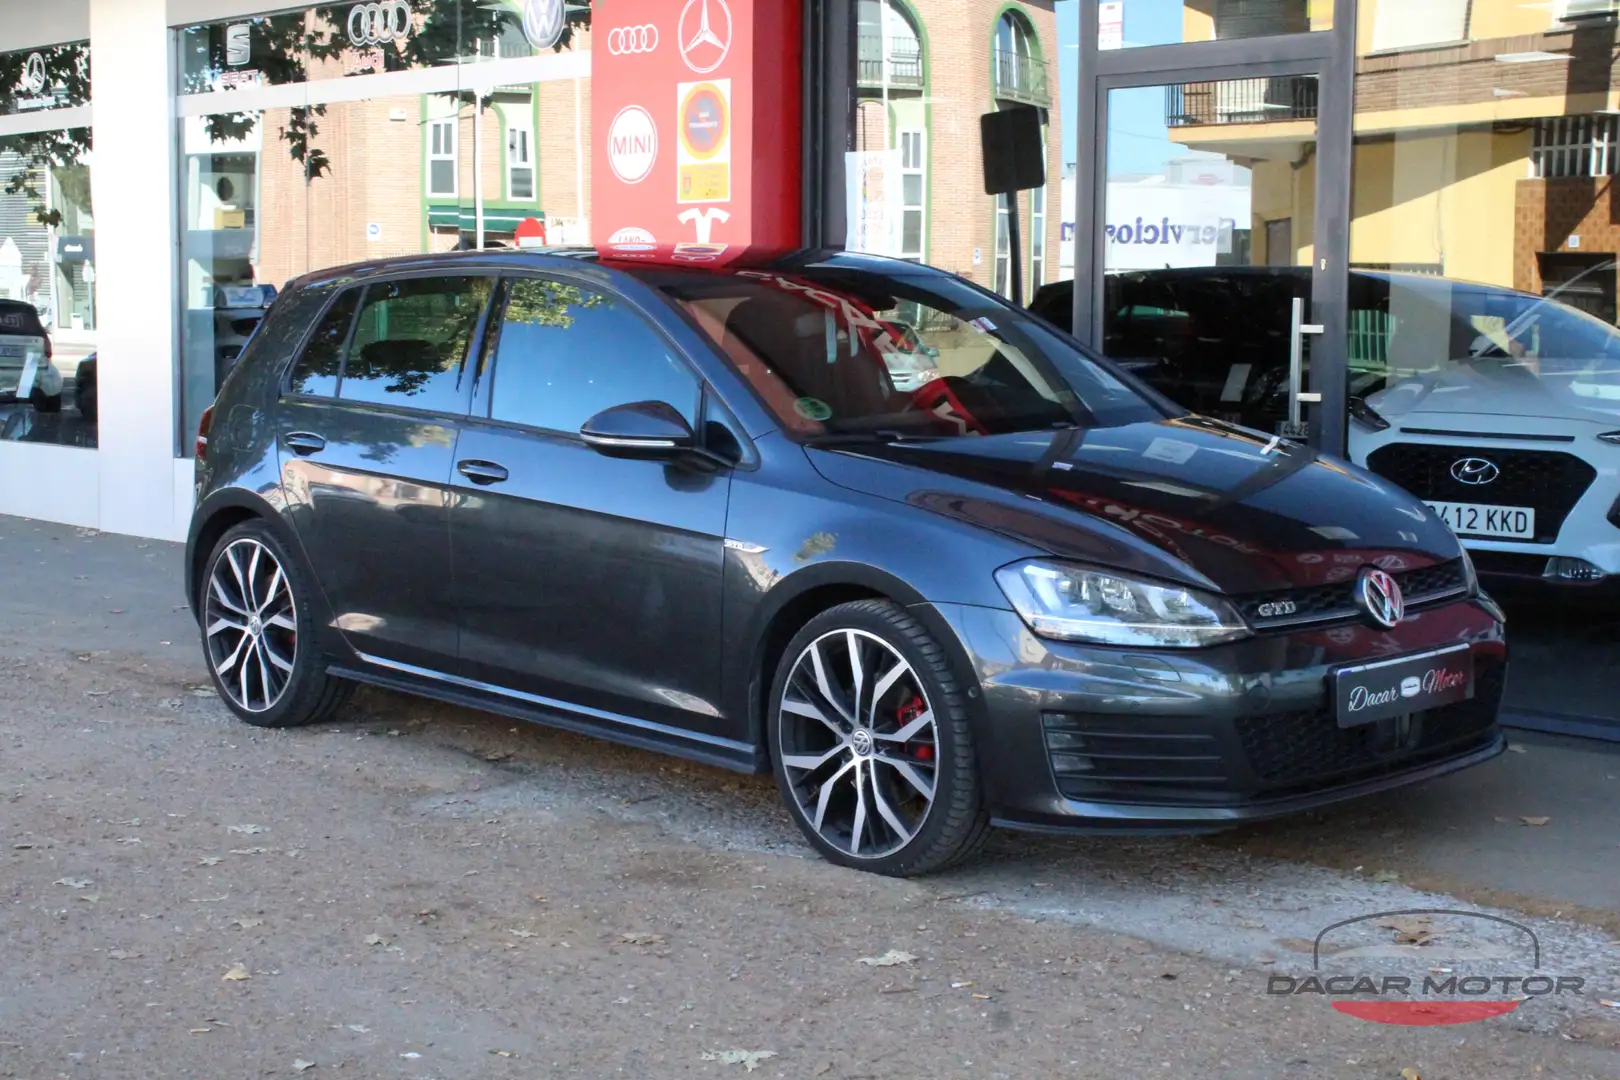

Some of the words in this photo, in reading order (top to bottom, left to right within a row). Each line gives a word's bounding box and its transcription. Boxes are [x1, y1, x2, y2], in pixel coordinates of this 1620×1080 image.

[220, 70, 258, 85] SEAT
[612, 135, 651, 155] MINI
[1486, 509, 1527, 533] KKD
[1348, 686, 1398, 712] Dacar
